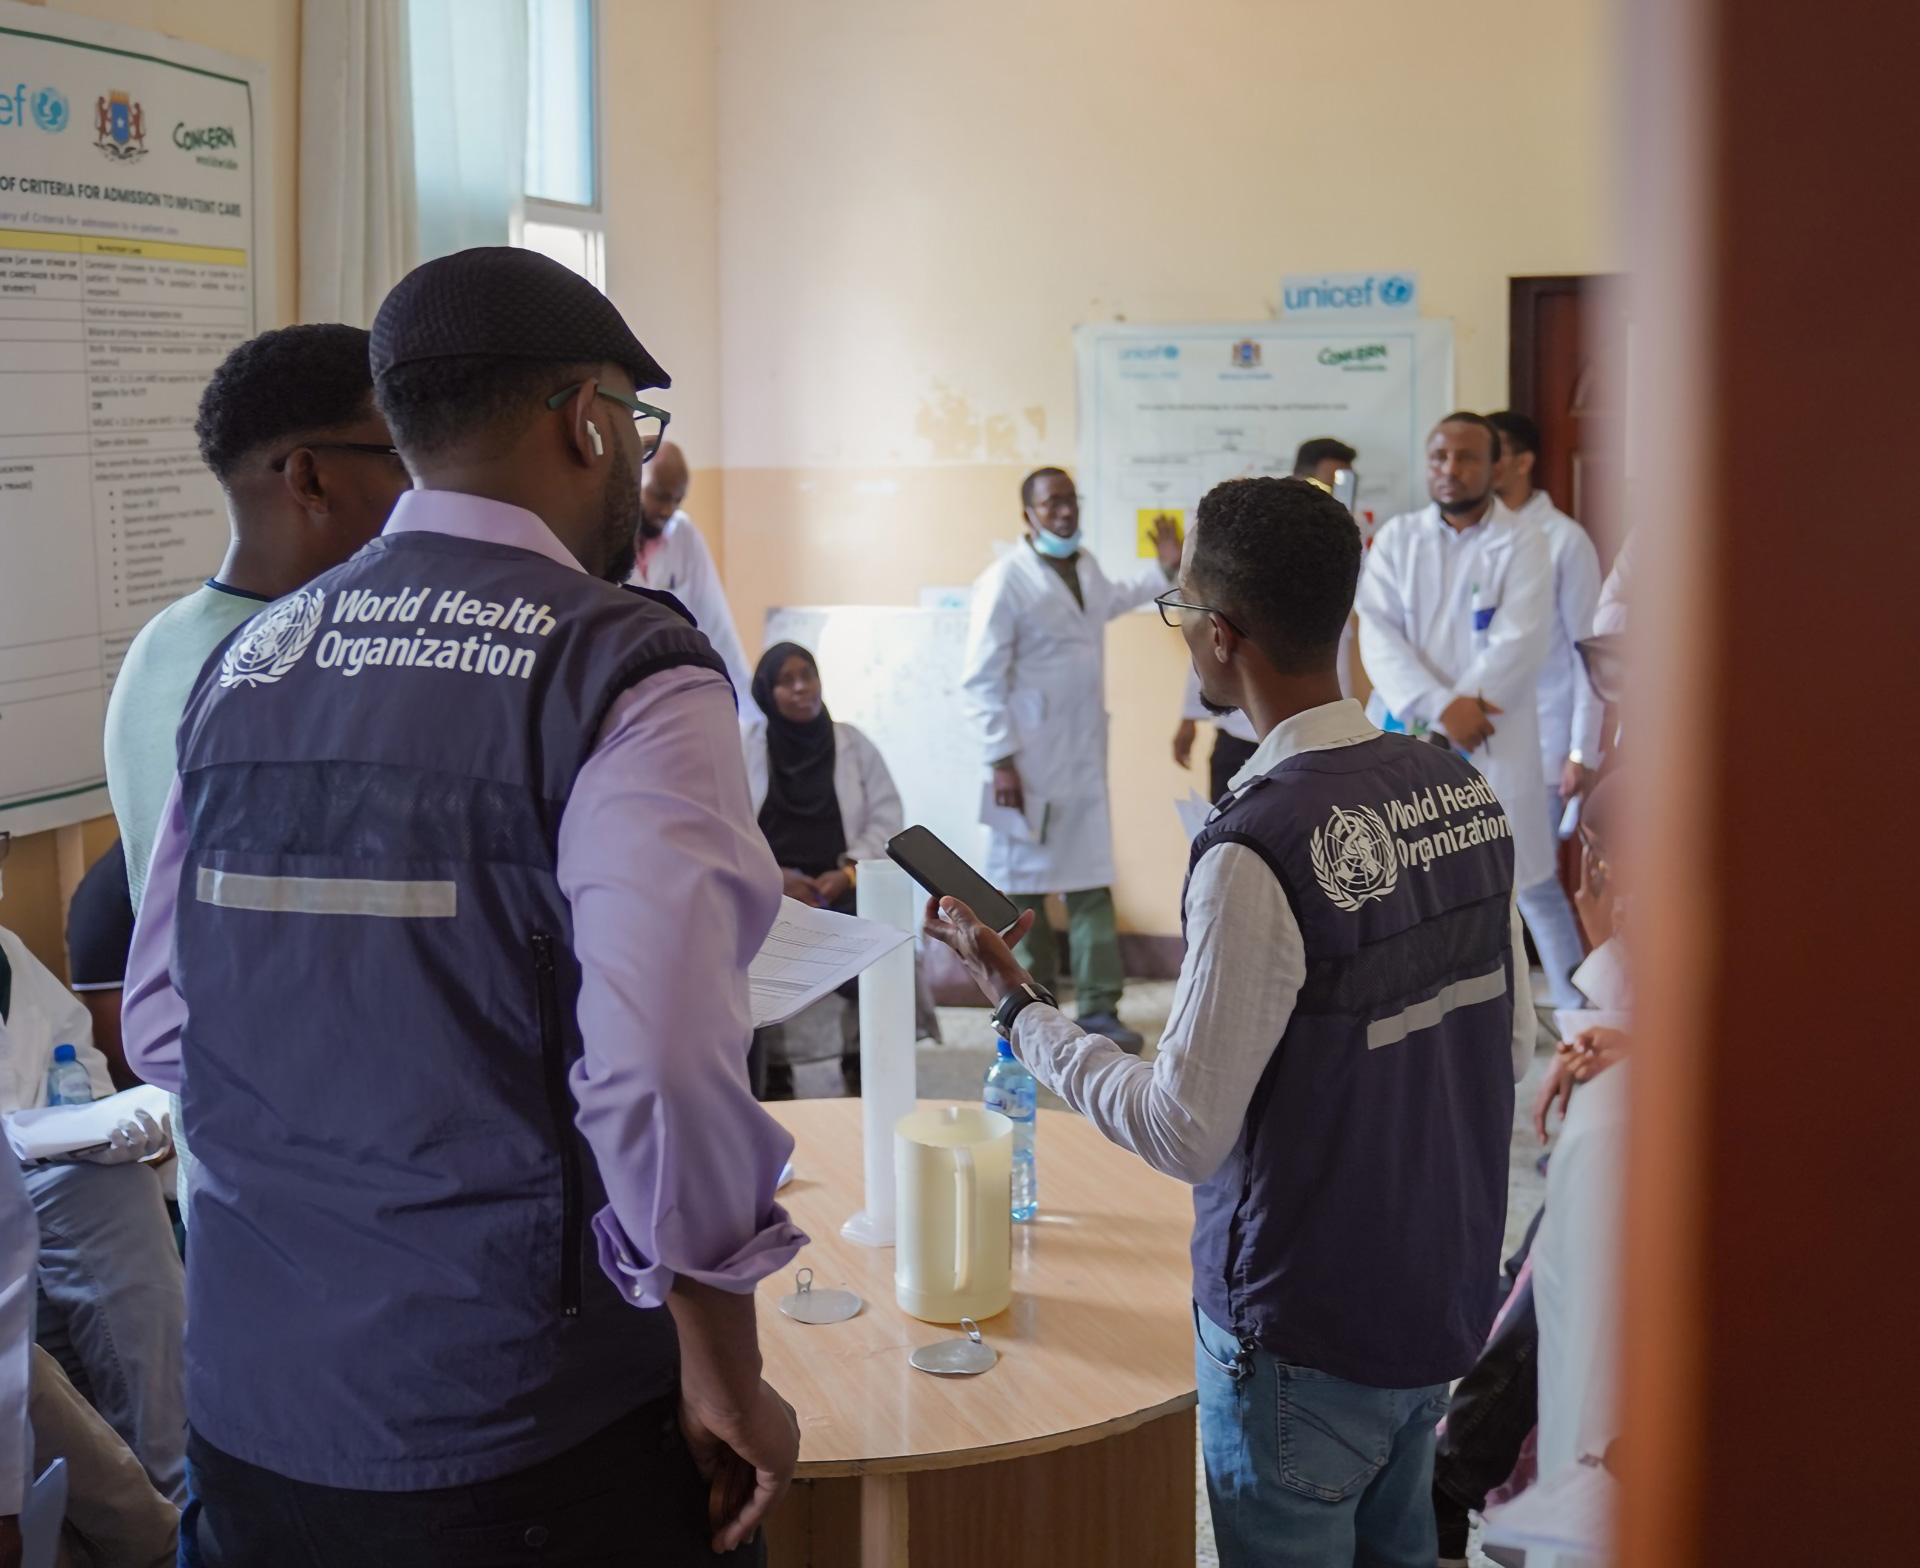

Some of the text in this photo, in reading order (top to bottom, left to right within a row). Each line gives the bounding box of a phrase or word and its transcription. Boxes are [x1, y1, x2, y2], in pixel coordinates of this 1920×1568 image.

[0, 177, 16, 190] OF
[19, 178, 75, 197] CRITERIA
[78, 183, 100, 200] FOR
[103, 187, 161, 207] ADMISSION
[218, 202, 242, 217] CARE
[1284, 277, 1375, 310] unicef
[332, 587, 557, 636] World Health
[315, 628, 537, 679] Organization
[1396, 811, 1512, 872] Organization
